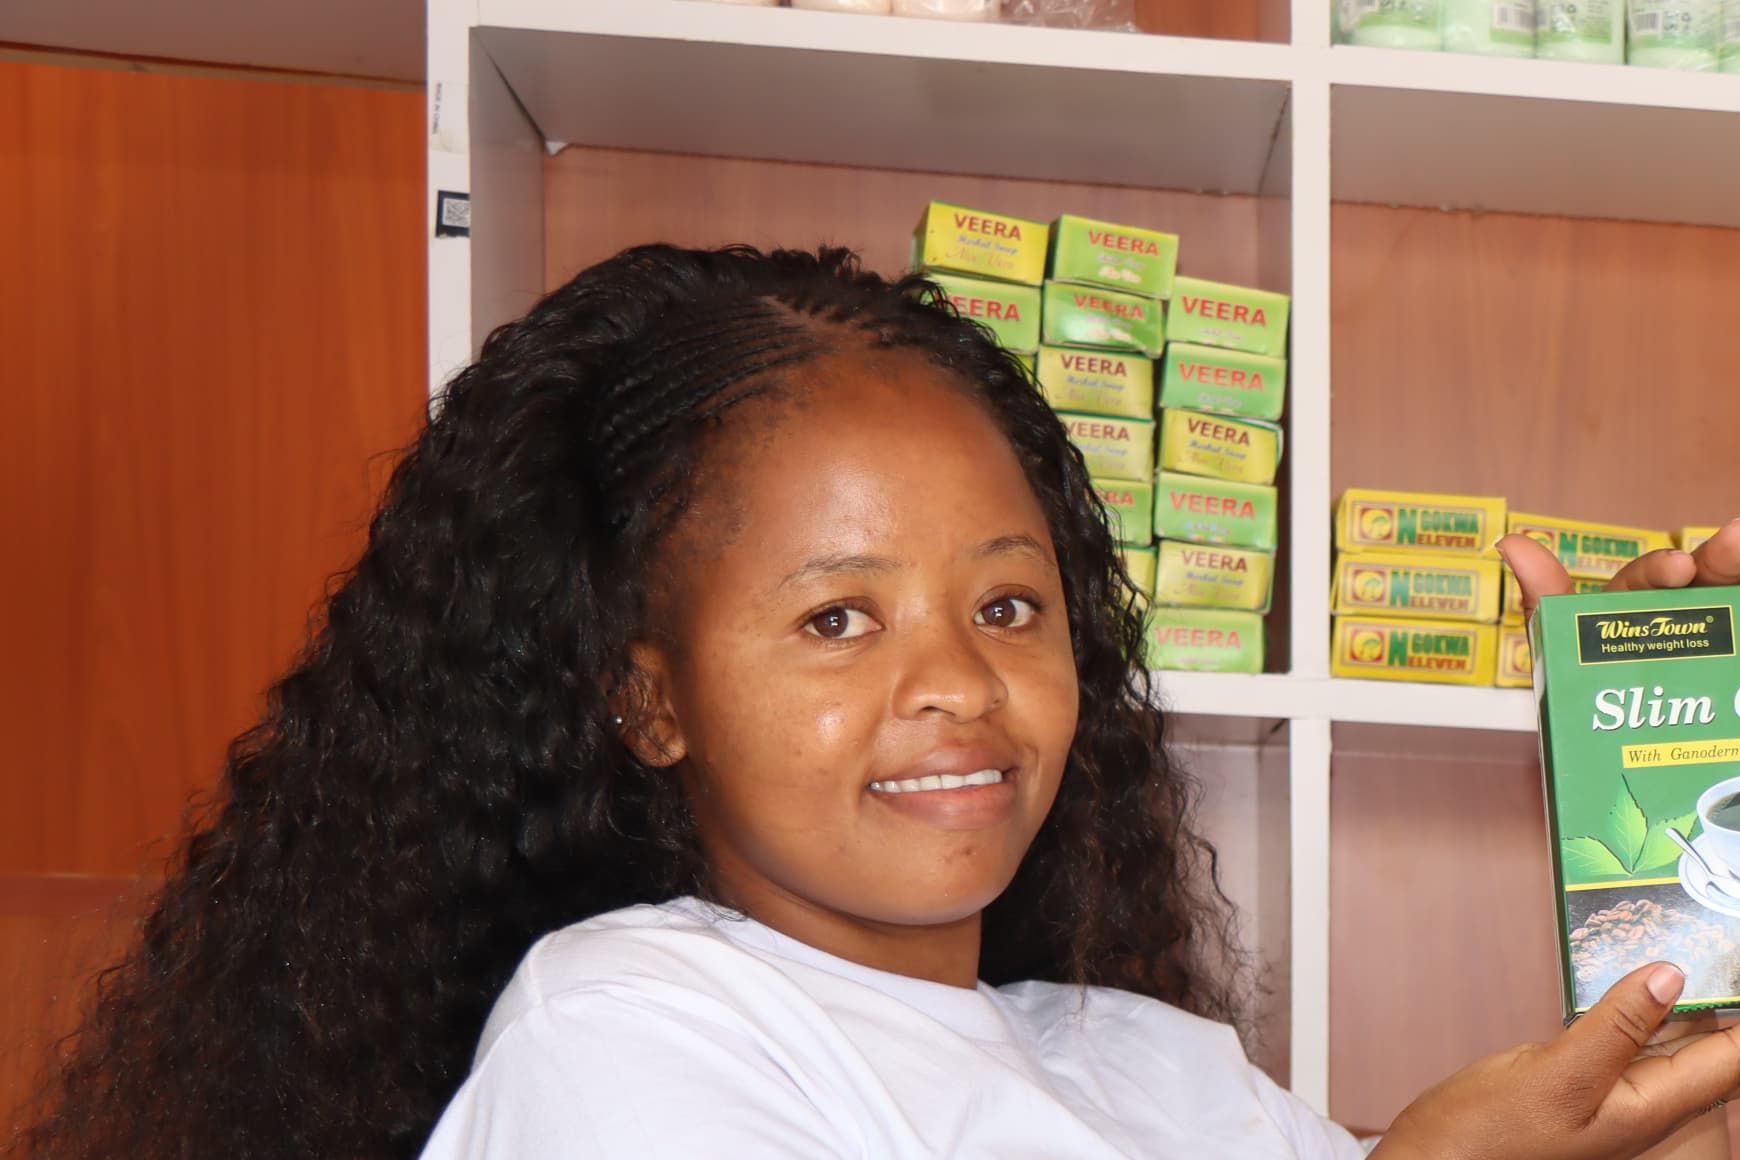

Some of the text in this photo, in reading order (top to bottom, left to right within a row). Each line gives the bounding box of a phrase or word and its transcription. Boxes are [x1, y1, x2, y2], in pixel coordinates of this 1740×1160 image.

[954, 213, 1022, 241] VEERA
[1088, 230, 1159, 257] VEERA
[1073, 293, 1145, 321] VEERA
[1182, 295, 1266, 327] VEERA
[1060, 353, 1127, 378] VEERA
[1178, 362, 1264, 391] VEERA
[1187, 418, 1250, 446] VEERA
[1169, 490, 1256, 519] VEERA
[1417, 533, 1476, 548] ELEVEN
[1182, 550, 1248, 572] VEERA
[1409, 596, 1469, 610] ELEVEN
[1155, 626, 1241, 648] VEERA
[1602, 638, 1710, 654] Healthy weight loss
[1407, 656, 1467, 670] ELEVEN
[1592, 686, 1716, 731] Slim
[1628, 749, 1662, 764] With
